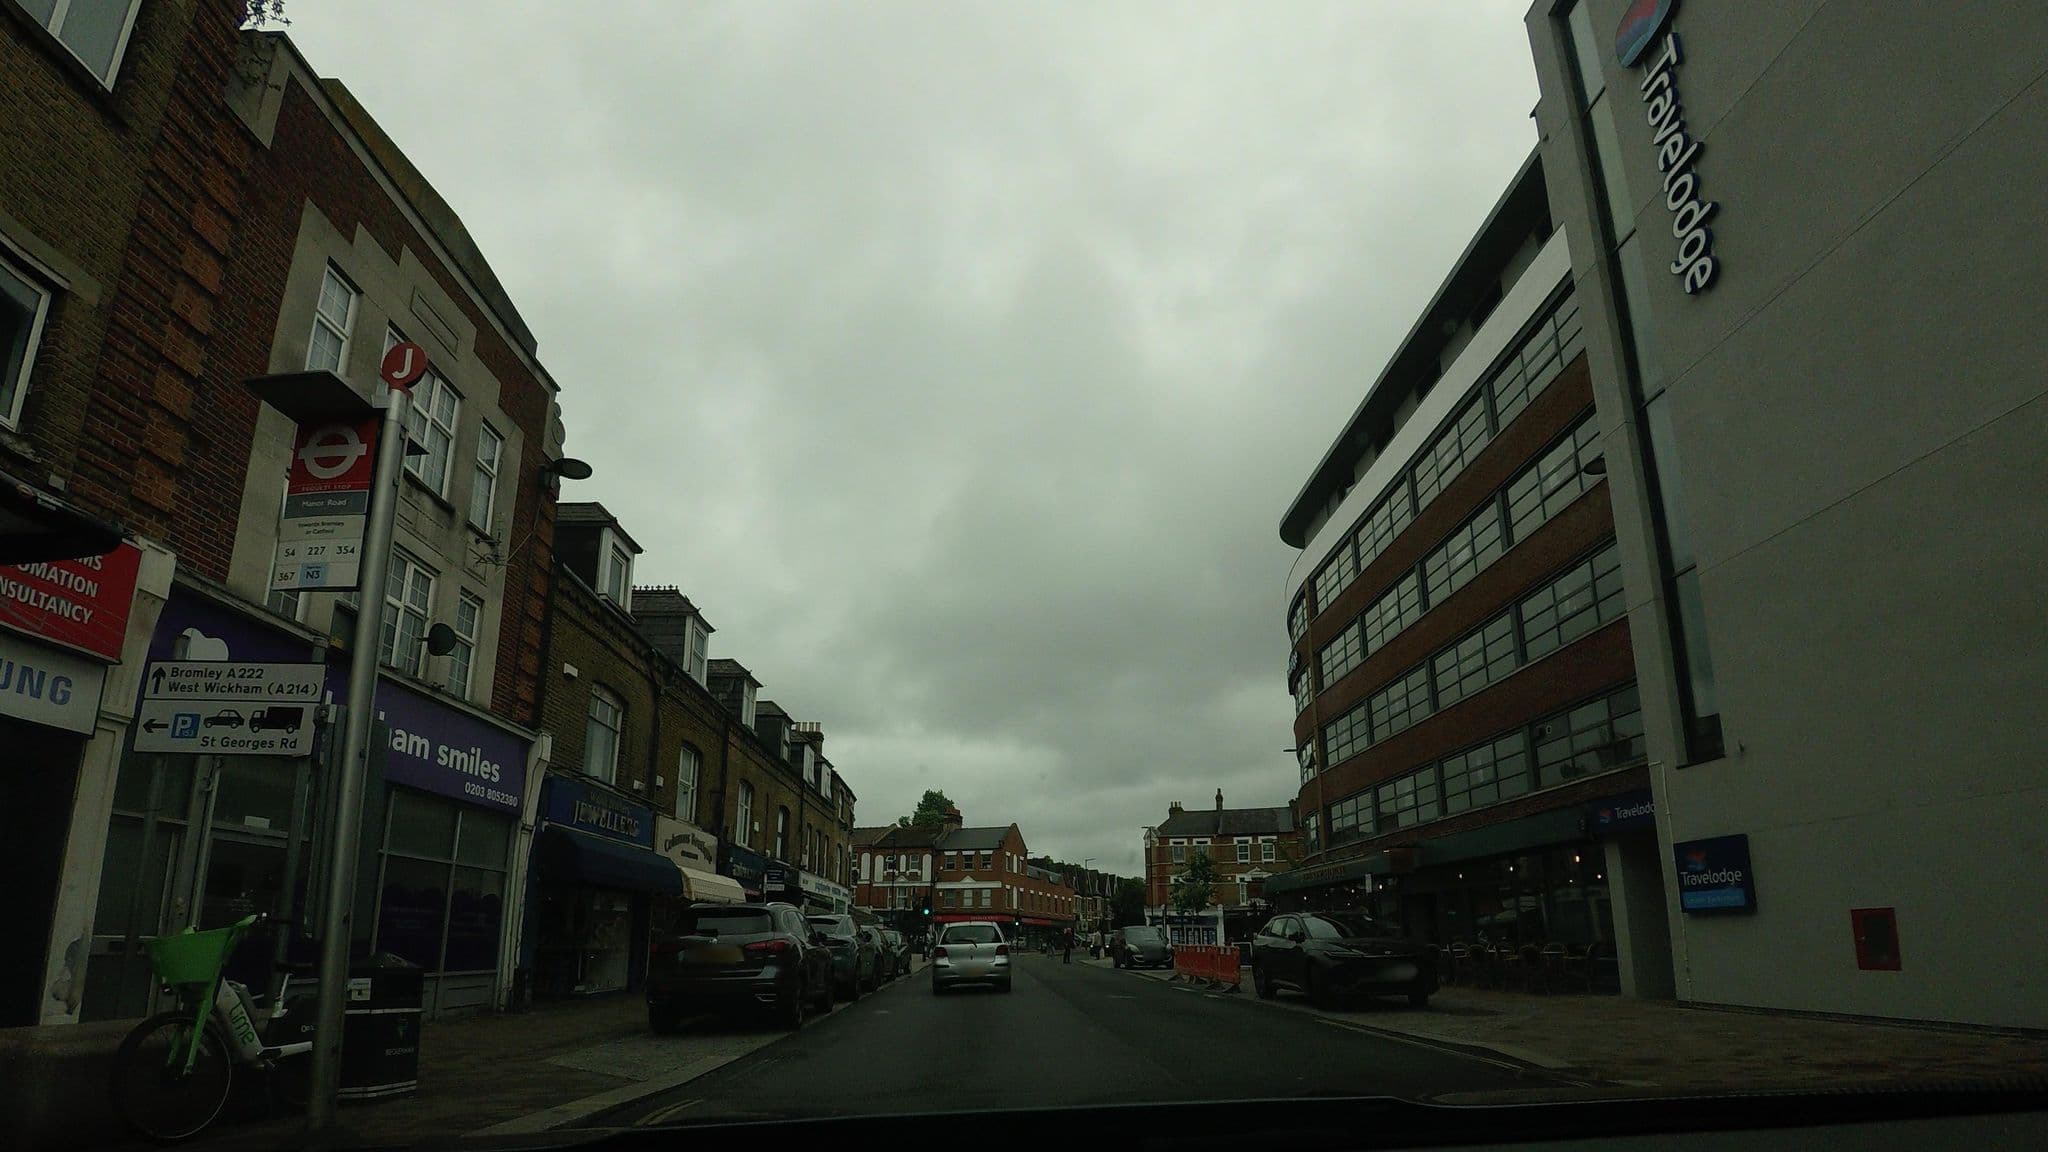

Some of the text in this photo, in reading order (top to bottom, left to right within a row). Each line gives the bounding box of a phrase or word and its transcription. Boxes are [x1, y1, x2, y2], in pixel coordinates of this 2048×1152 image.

[1641, 32, 1718, 294] Travelodge
[392, 348, 413, 379] J
[327, 498, 347, 507] Road
[284, 545, 355, 557] 54 227 354
[278, 570, 320, 582] 367 N3
[170, 667, 264, 681] Bromley A222
[168, 681, 318, 696] West Wickham (A214)
[200, 736, 298, 750] St Georges Rd
[388, 727, 501, 784] am smiles
[464, 781, 486, 798] 0203
[1680, 866, 1743, 887] Travelodge
[229, 1003, 256, 1045] Lime
